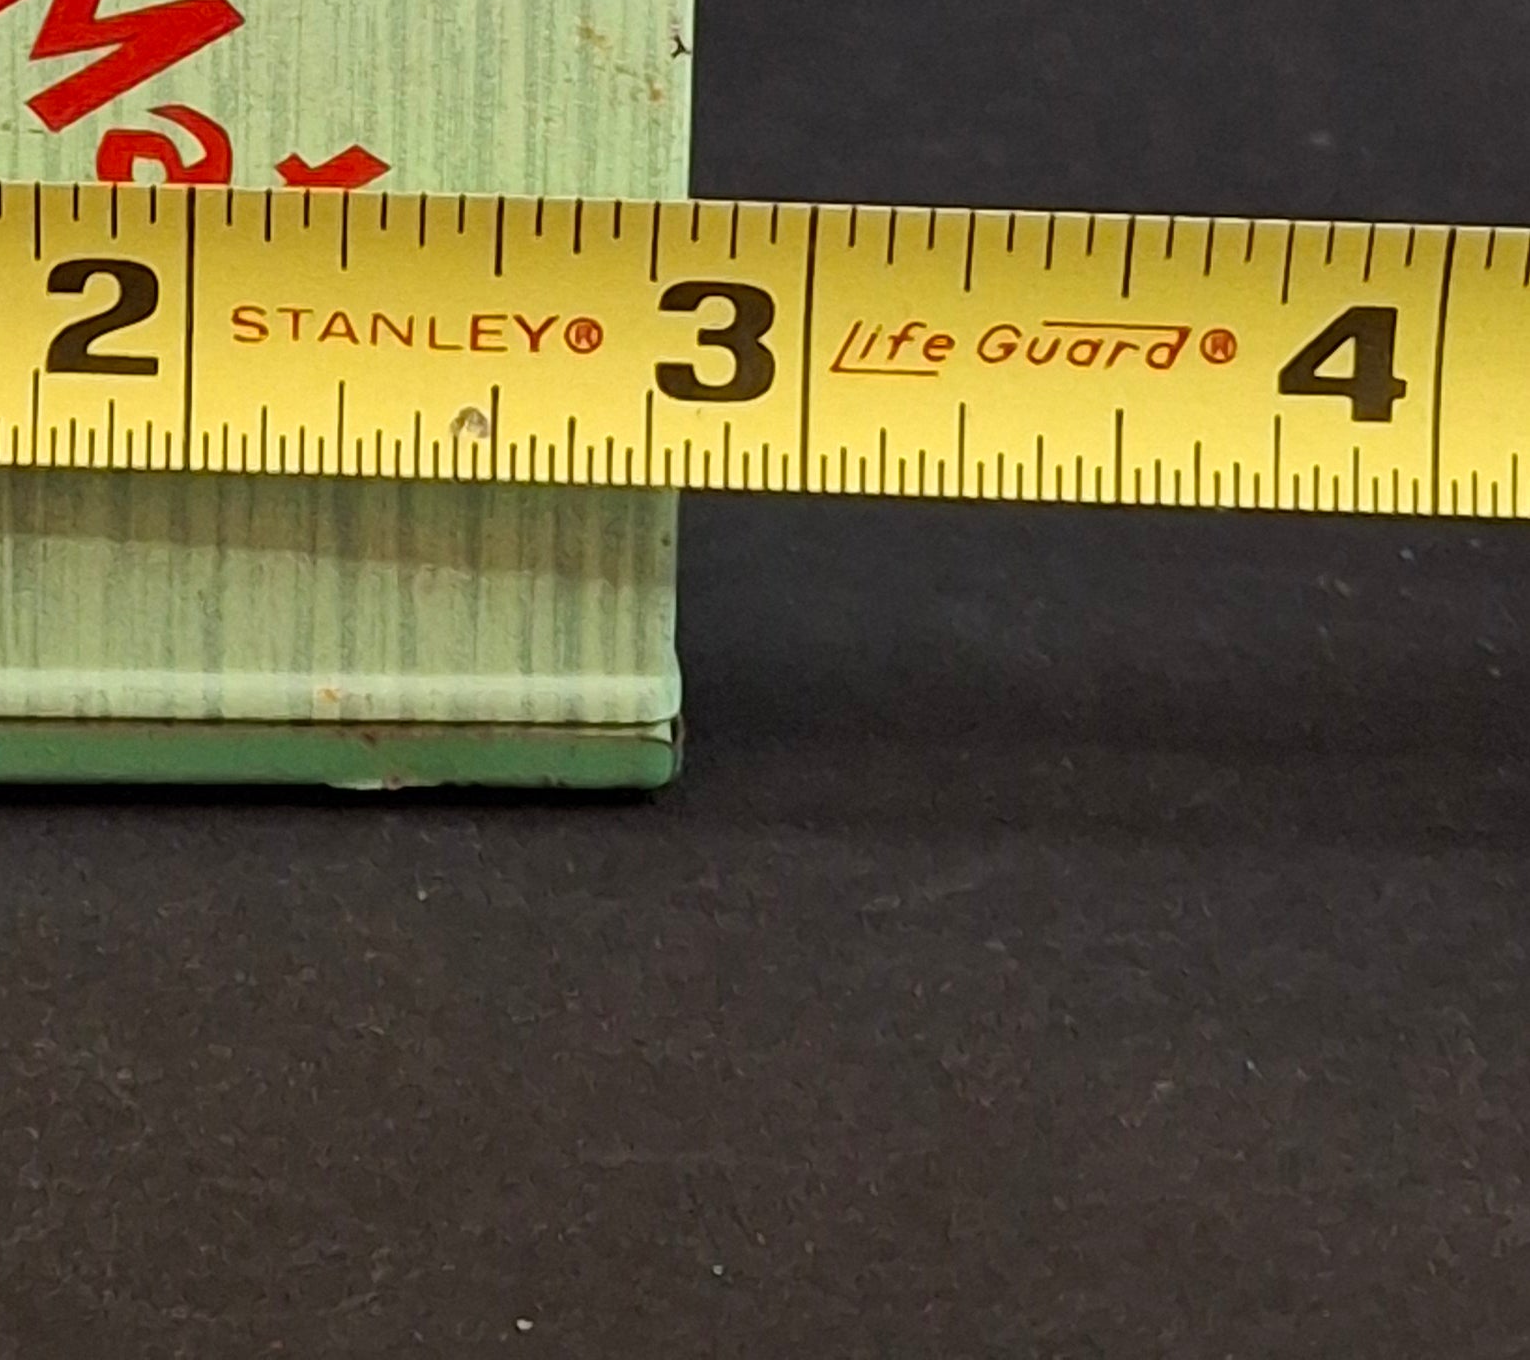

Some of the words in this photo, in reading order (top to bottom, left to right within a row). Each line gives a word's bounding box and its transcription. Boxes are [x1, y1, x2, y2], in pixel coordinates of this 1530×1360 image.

[45, 257, 160, 377] 2
[654, 280, 777, 403] 3
[830, 320, 957, 376] Life
[1278, 305, 1408, 423] 4
